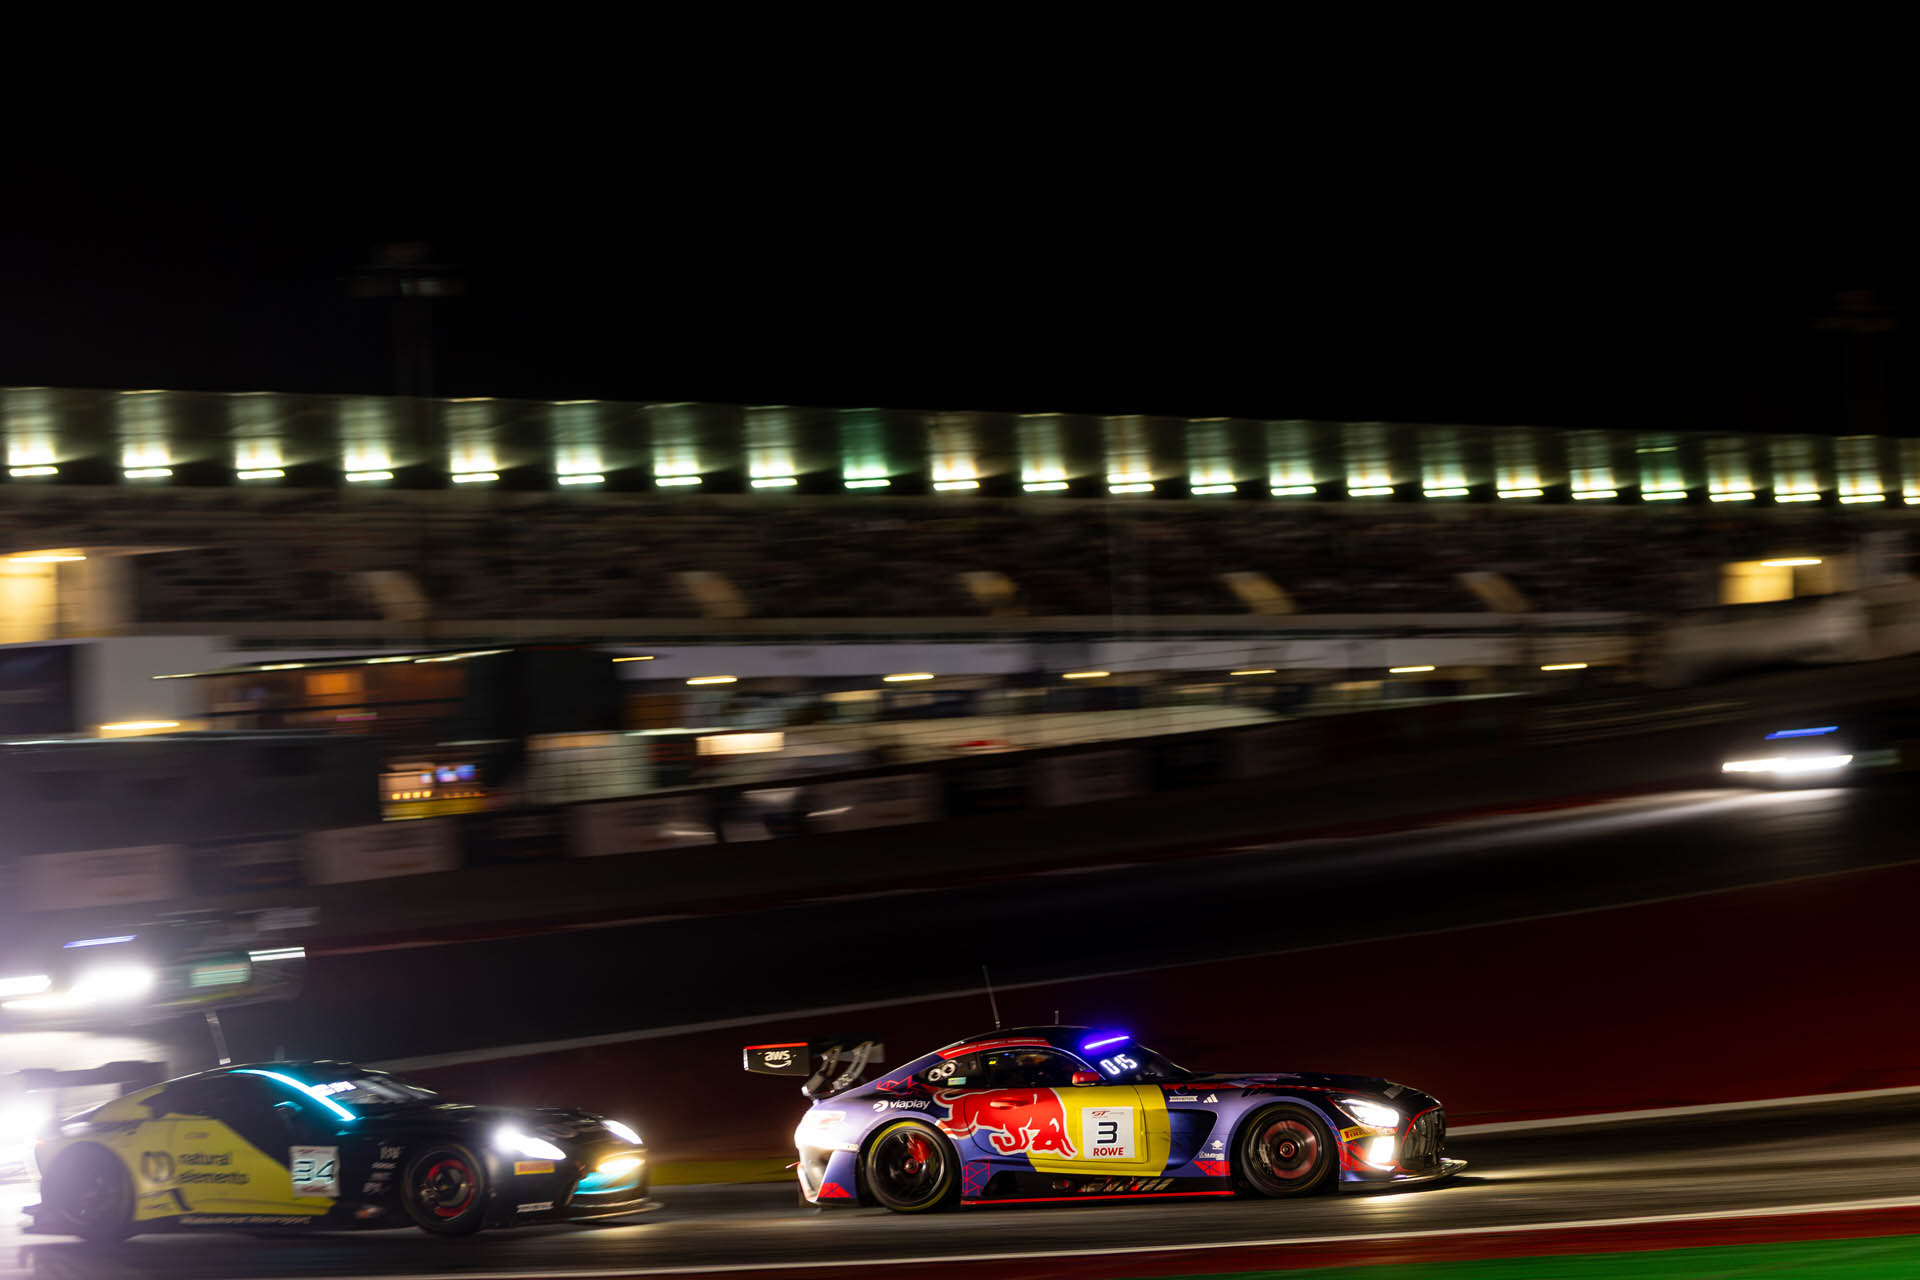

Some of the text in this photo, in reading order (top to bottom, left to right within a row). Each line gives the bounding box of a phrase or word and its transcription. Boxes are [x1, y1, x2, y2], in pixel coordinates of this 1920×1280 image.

[764, 1050, 791, 1061] aws
[890, 1099, 931, 1110] viaplay
[1097, 1121, 1118, 1144] 3
[1093, 1147, 1124, 1157] ROWE
[292, 1159, 336, 1184] 34
